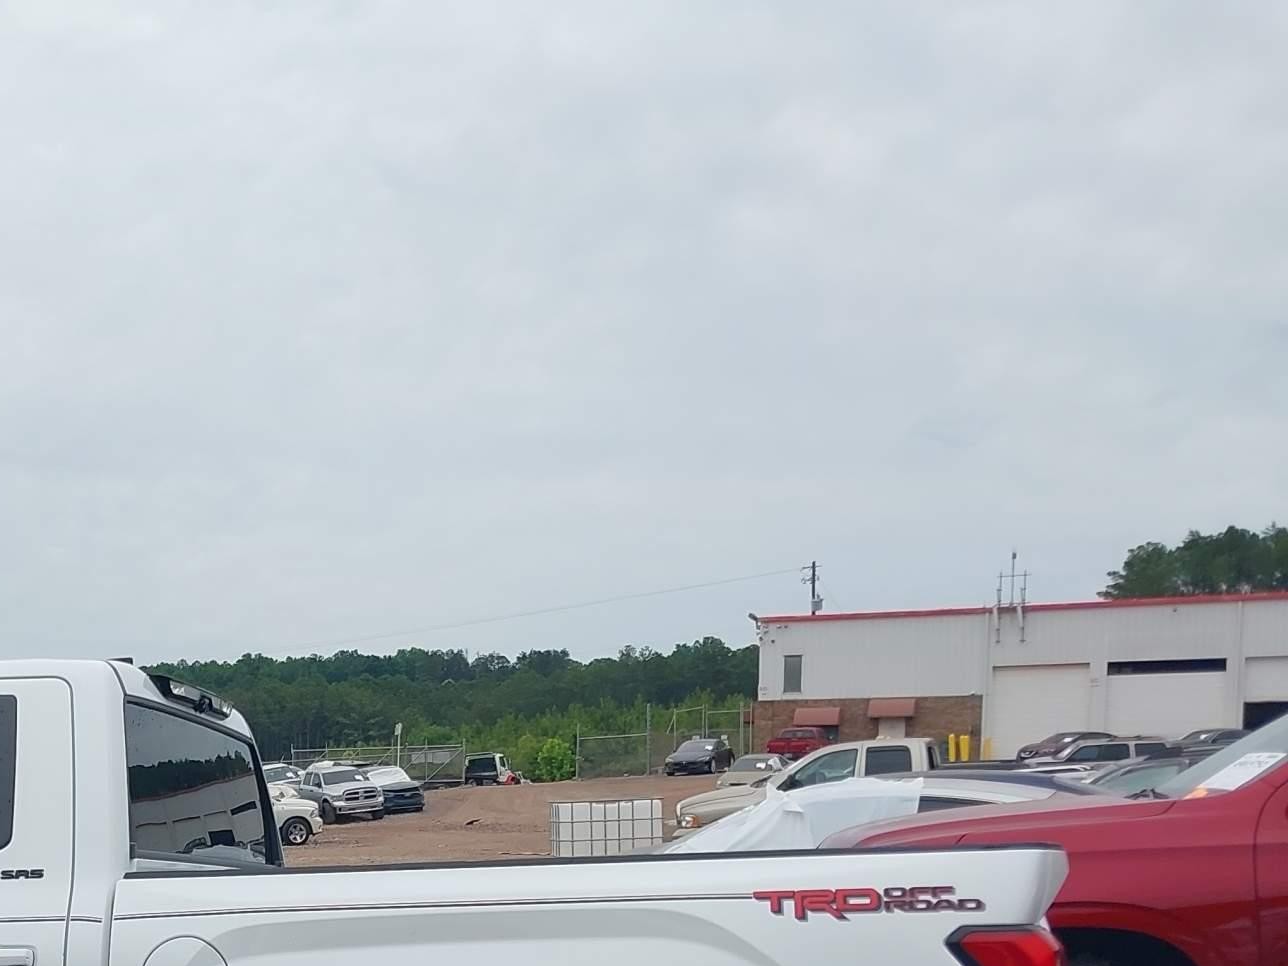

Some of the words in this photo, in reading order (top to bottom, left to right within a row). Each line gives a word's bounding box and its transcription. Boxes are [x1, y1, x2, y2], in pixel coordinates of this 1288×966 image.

[883, 886, 956, 900] OFF
[753, 887, 883, 922] TRD
[884, 898, 986, 913] ROAD
